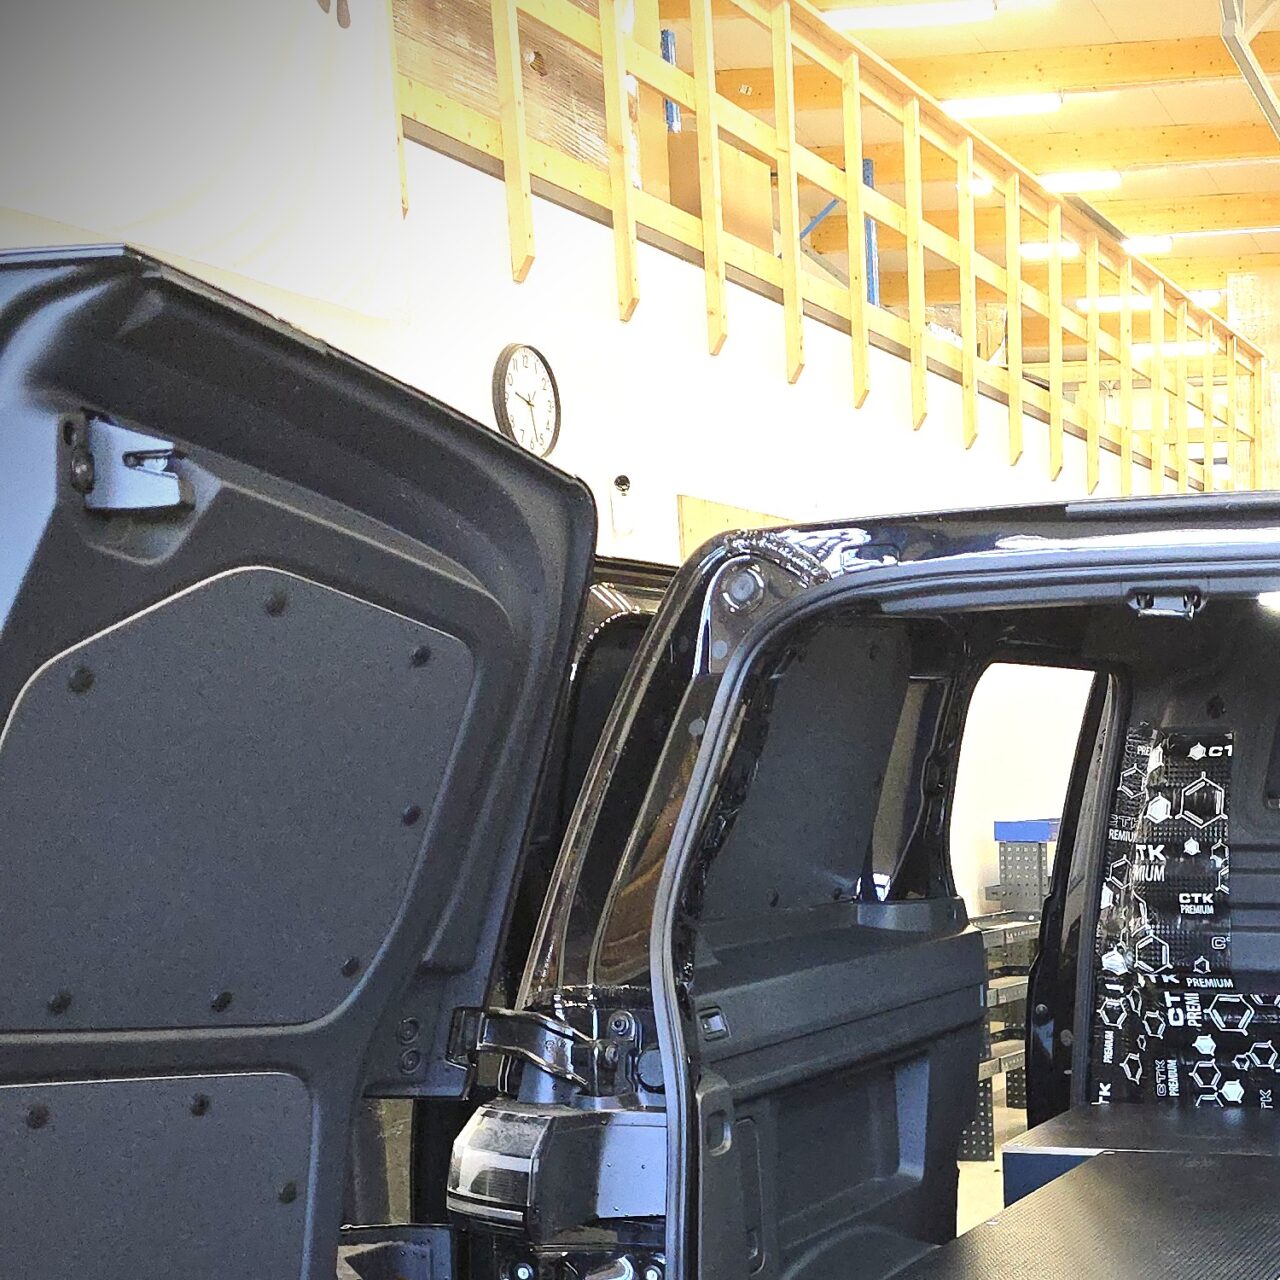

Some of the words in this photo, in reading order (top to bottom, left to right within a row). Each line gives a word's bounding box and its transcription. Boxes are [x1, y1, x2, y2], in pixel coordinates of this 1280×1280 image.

[1178, 893, 1214, 904] CTK
[1180, 904, 1215, 915] PREMIUM
[1186, 977, 1234, 988] PREMIUM
[1103, 1031, 1114, 1064] PREMIUM
[1154, 1059, 1167, 1097] CTK
[1167, 1059, 1180, 1097] PREMIUM
